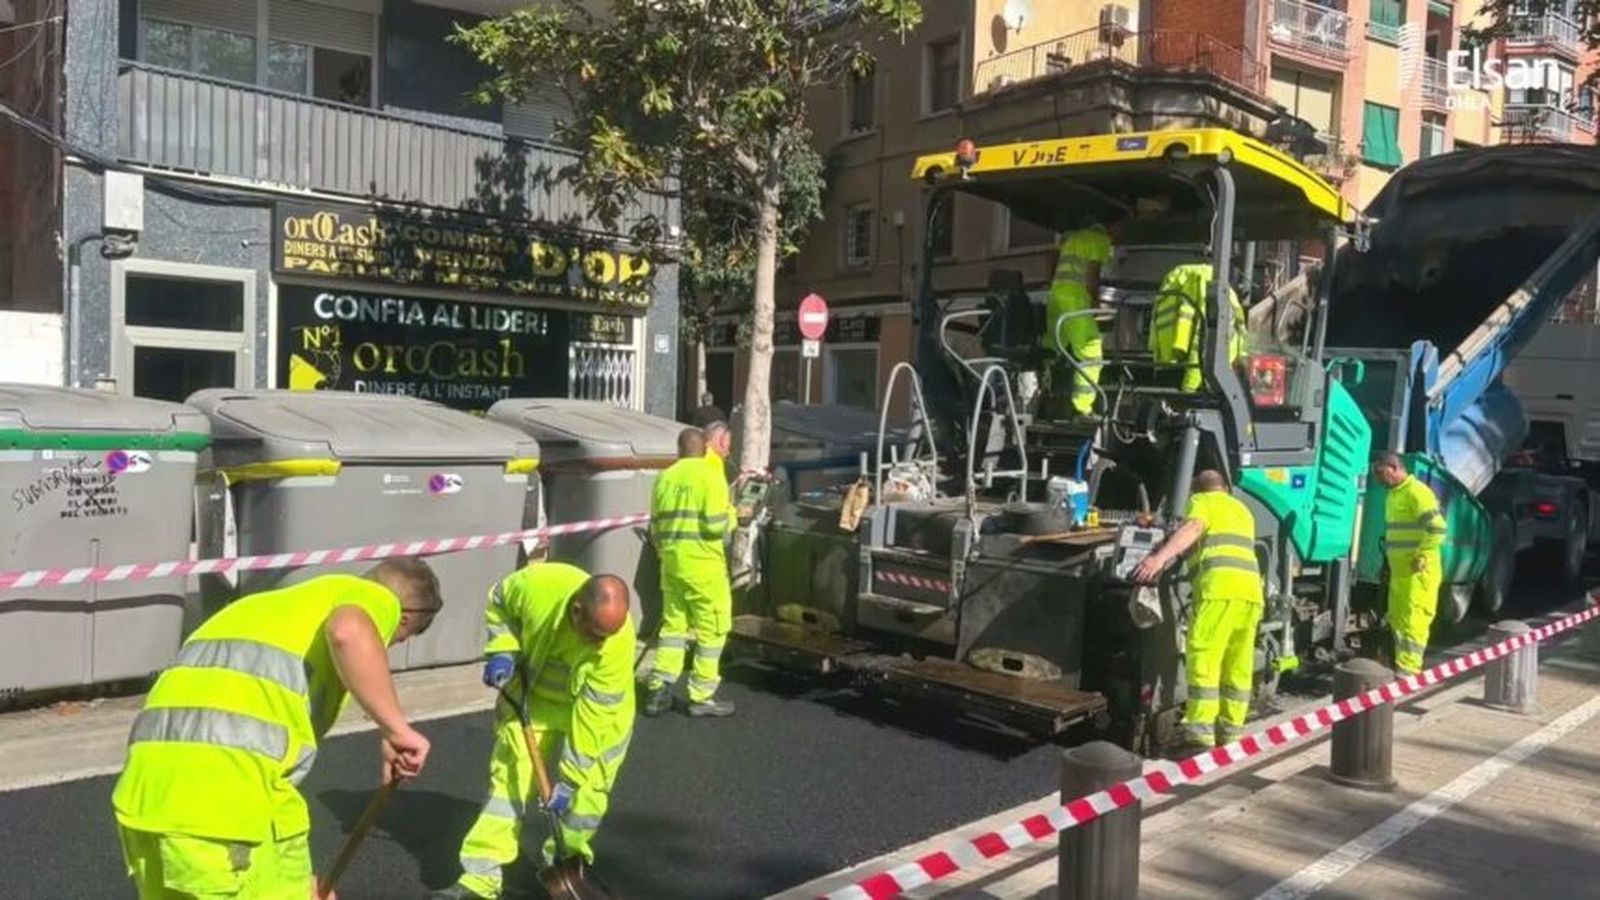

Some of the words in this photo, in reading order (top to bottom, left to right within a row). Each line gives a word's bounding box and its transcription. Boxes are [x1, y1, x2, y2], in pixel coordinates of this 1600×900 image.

[284, 240, 327, 258] DINERS
[329, 244, 337, 259] A
[313, 292, 426, 327] CONFIA
[431, 304, 466, 329] AL
[470, 306, 548, 336] LIDER!
[354, 379, 416, 398] DINERS
[418, 383, 431, 399] A
